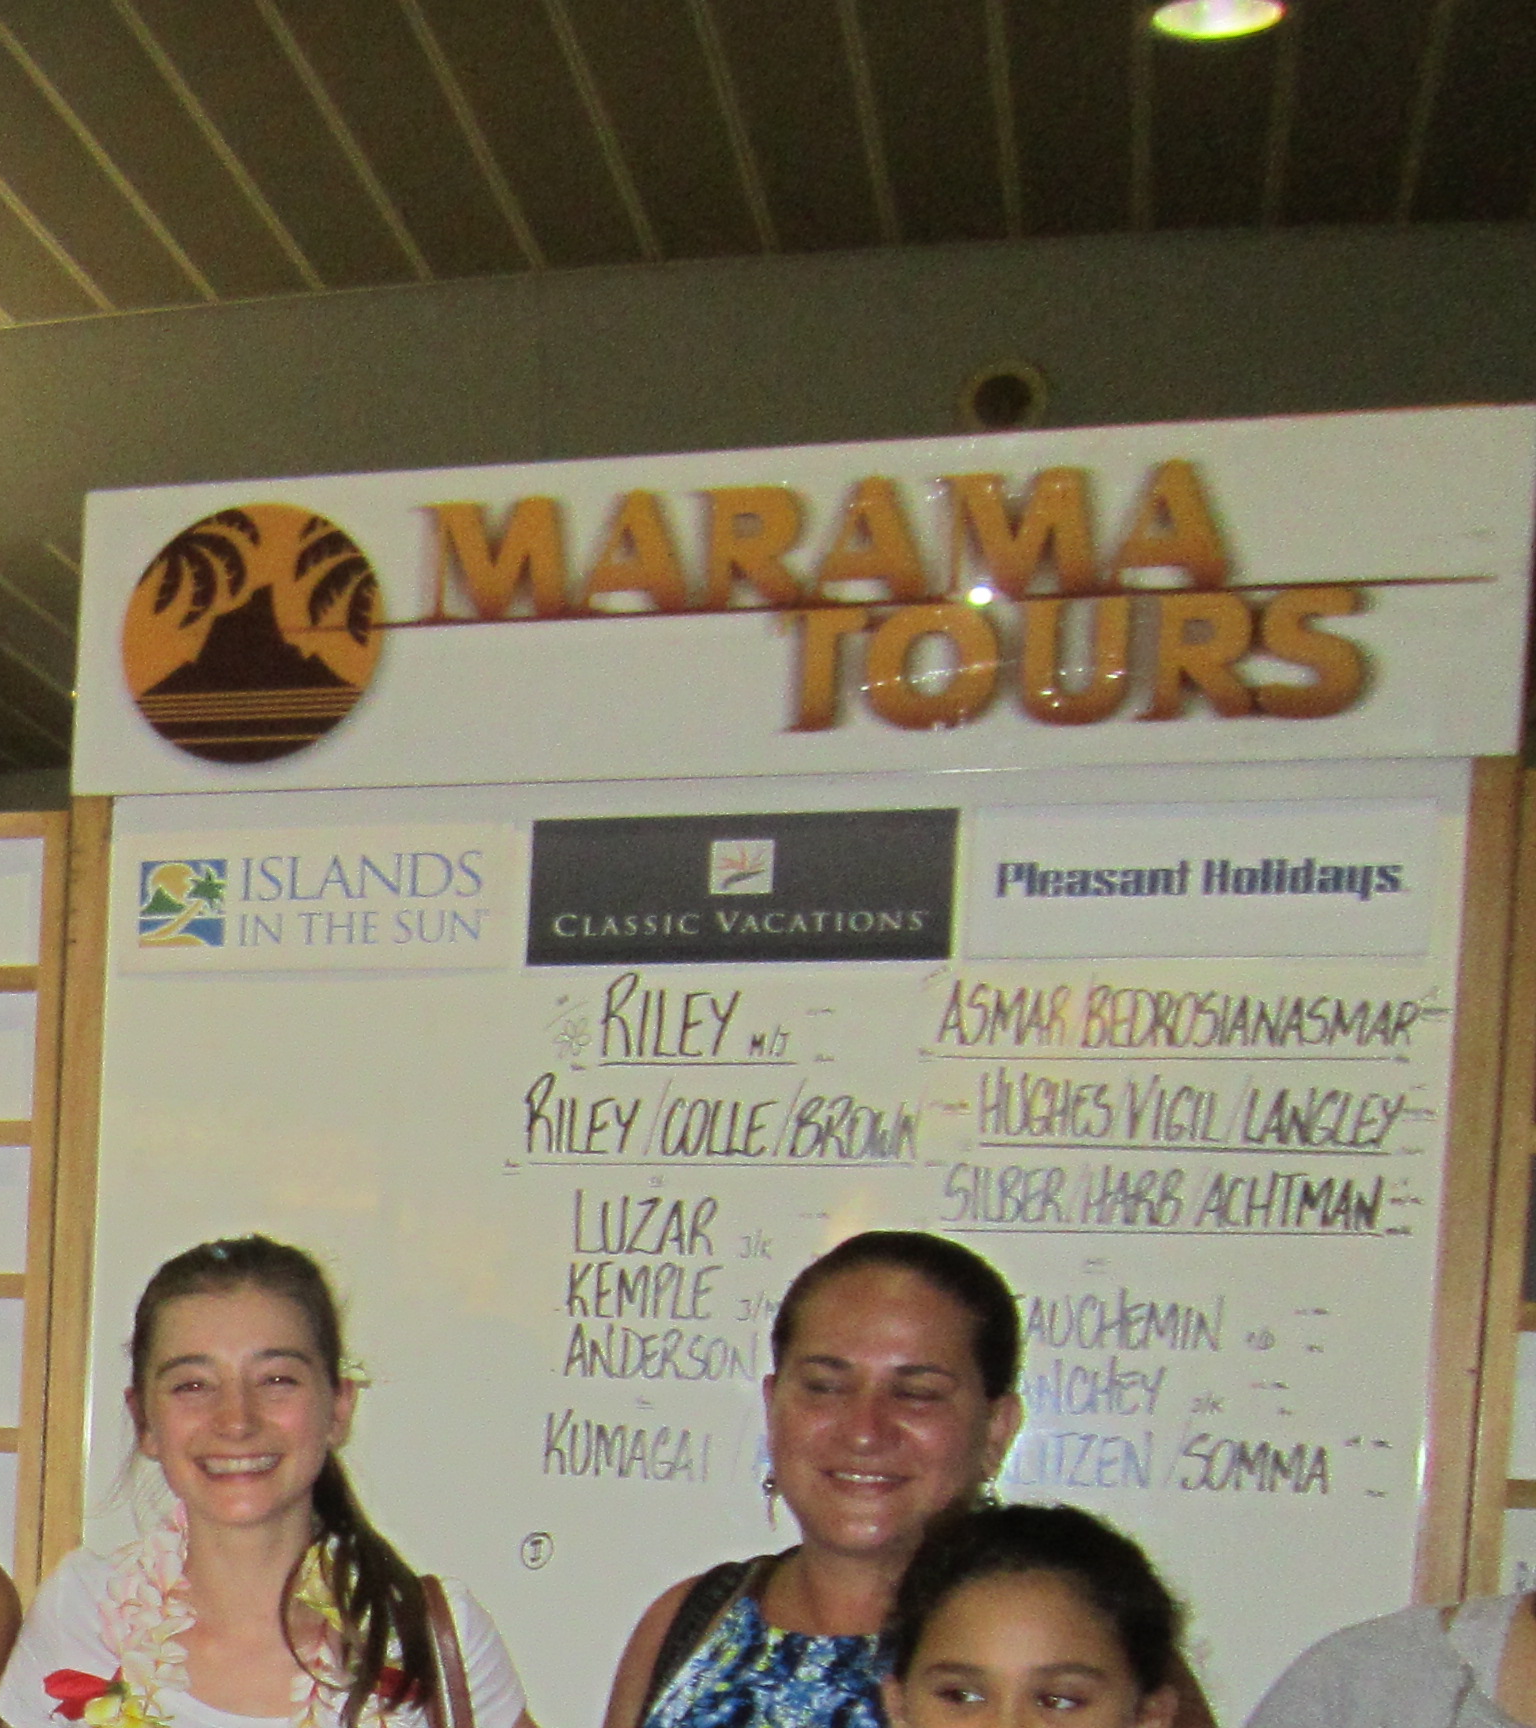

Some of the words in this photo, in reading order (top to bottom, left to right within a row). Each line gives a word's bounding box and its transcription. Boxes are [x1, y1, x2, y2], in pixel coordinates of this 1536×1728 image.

[417, 459, 1232, 624] MARAMA
[778, 585, 1371, 732] TOURS
[242, 850, 483, 902] ISLANDS
[996, 859, 1188, 898] Pleasant
[1203, 857, 1405, 900] Holidays
[239, 912, 288, 946] IN
[299, 910, 383, 945] THE
[396, 907, 481, 943] SUN
[554, 913, 701, 938] CLASSIC
[716, 910, 925, 934] VACATIONS
[601, 972, 742, 1057] RILEY
[574, 1188, 719, 1256] LUZAR
[566, 1260, 724, 1320] KEMPLE
[1025, 1287, 1226, 1352] AUCHEMIN
[564, 1322, 759, 1381] ANDERSON
[543, 1409, 712, 1482] KUMAGAI
